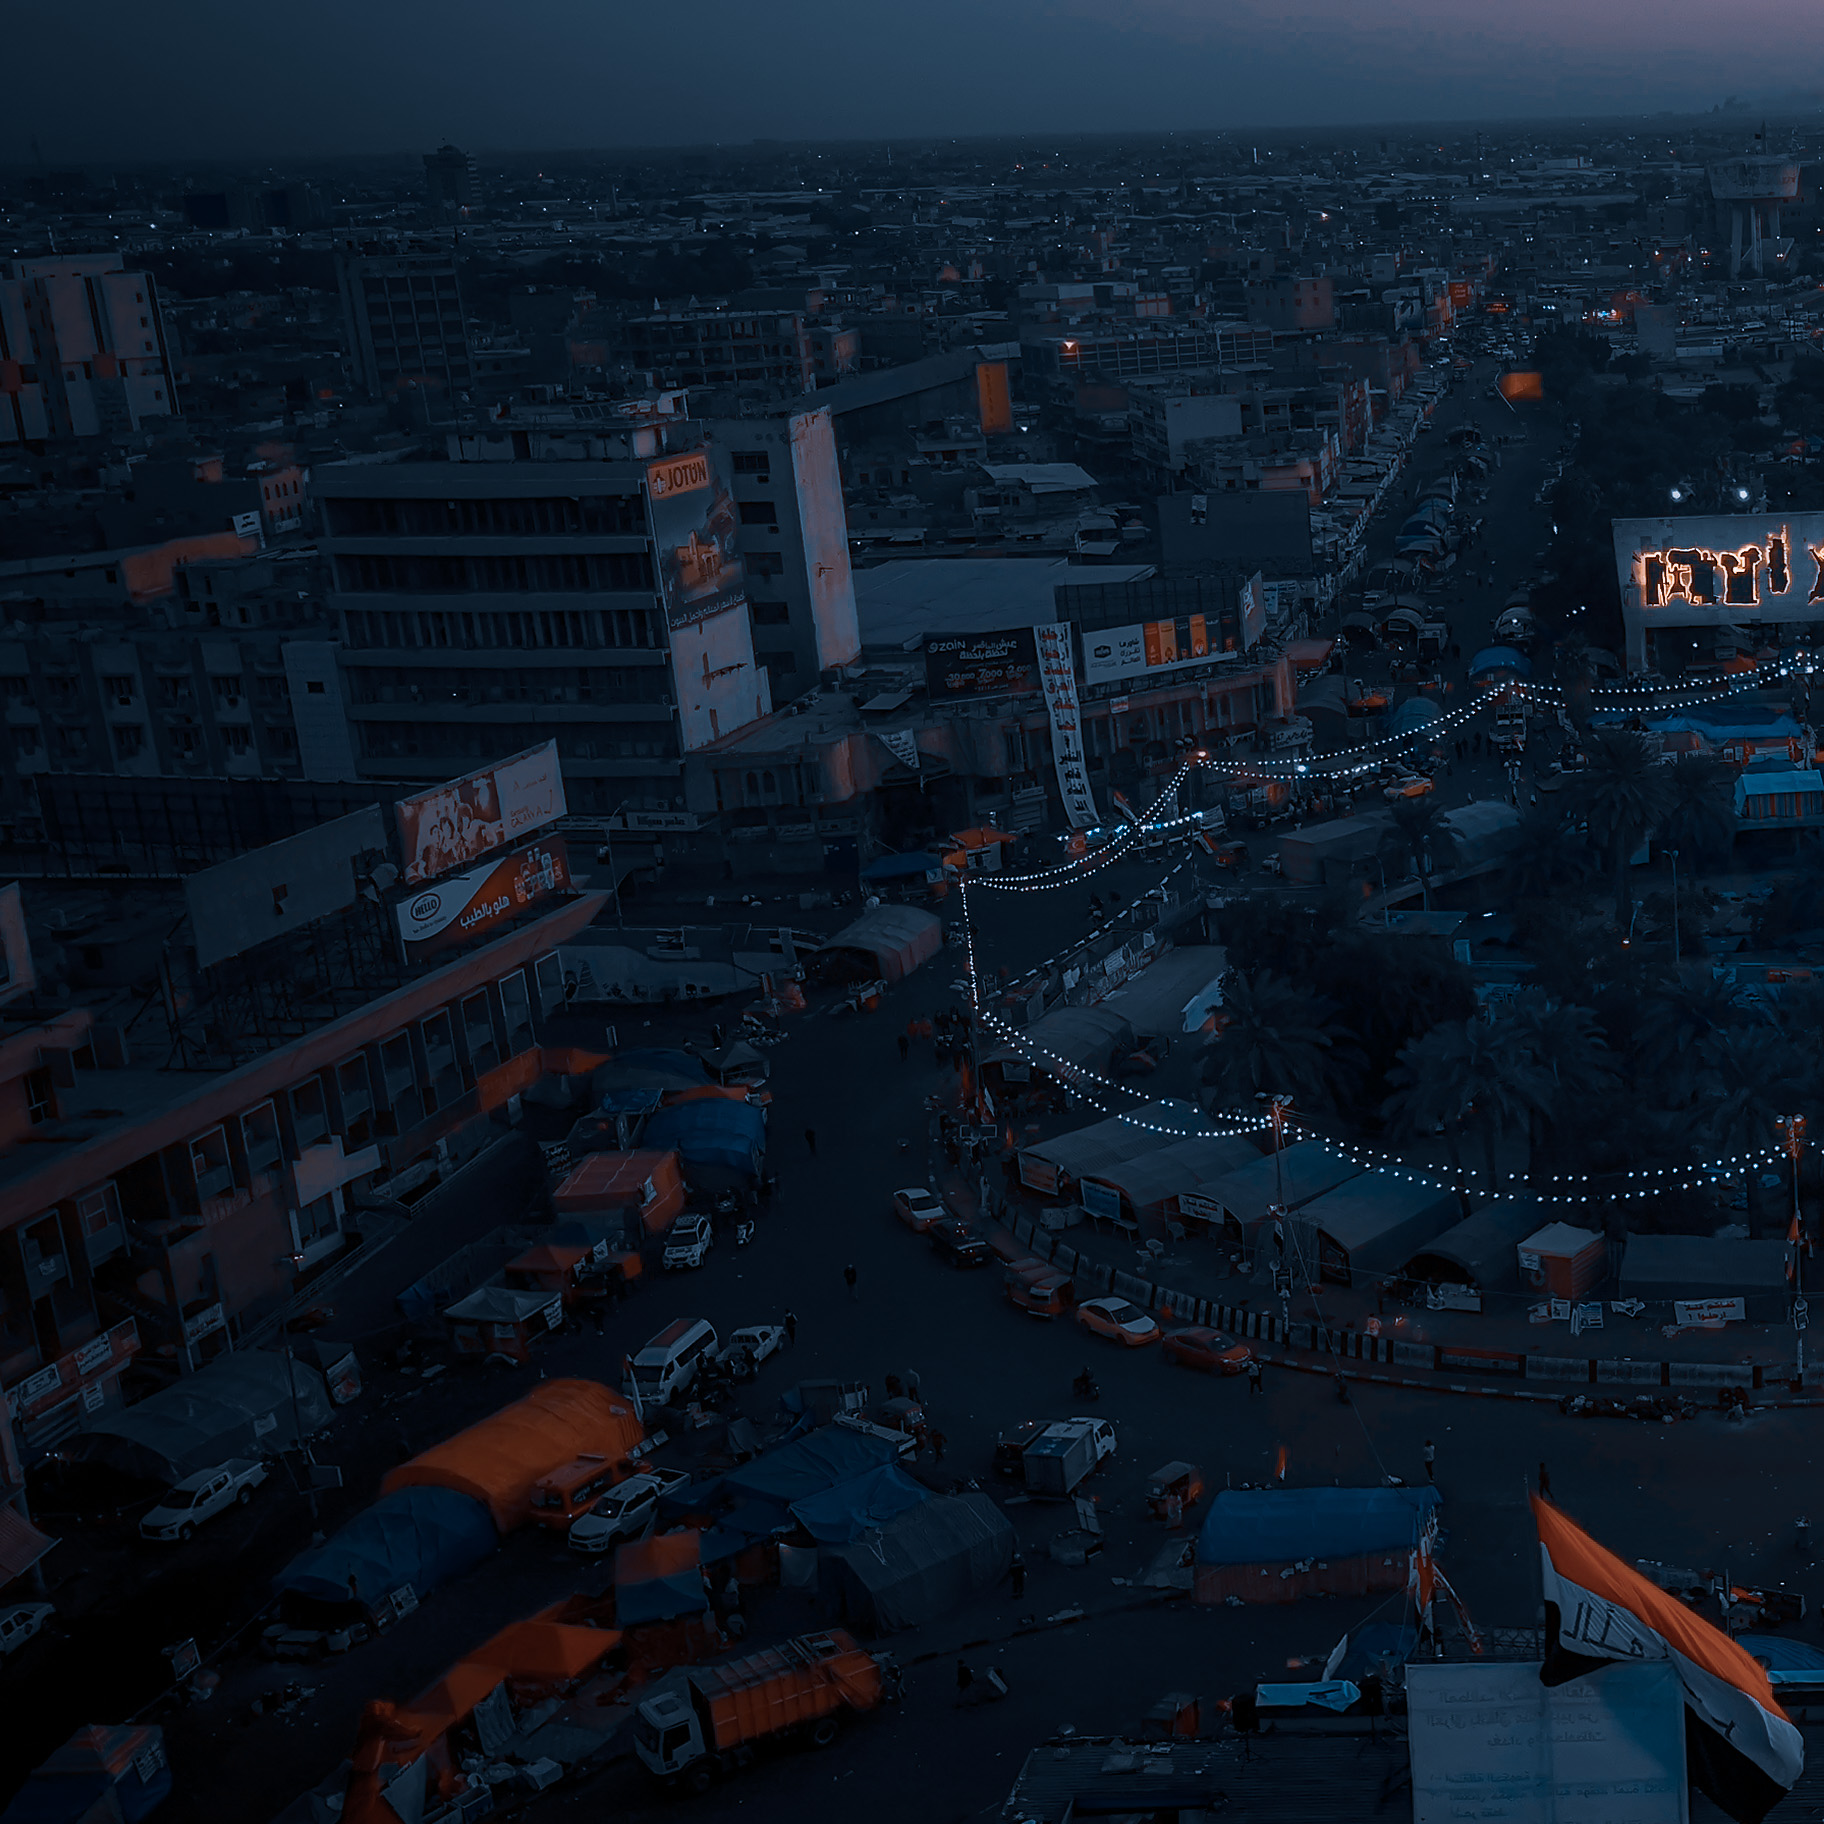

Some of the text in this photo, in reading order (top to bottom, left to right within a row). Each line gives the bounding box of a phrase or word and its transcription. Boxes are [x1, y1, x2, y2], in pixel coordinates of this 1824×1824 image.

[668, 459, 707, 491] JOTUN
[938, 638, 966, 652] zain
[414, 899, 438, 917] HELLO
[459, 895, 511, 930] هلو بالطيب
